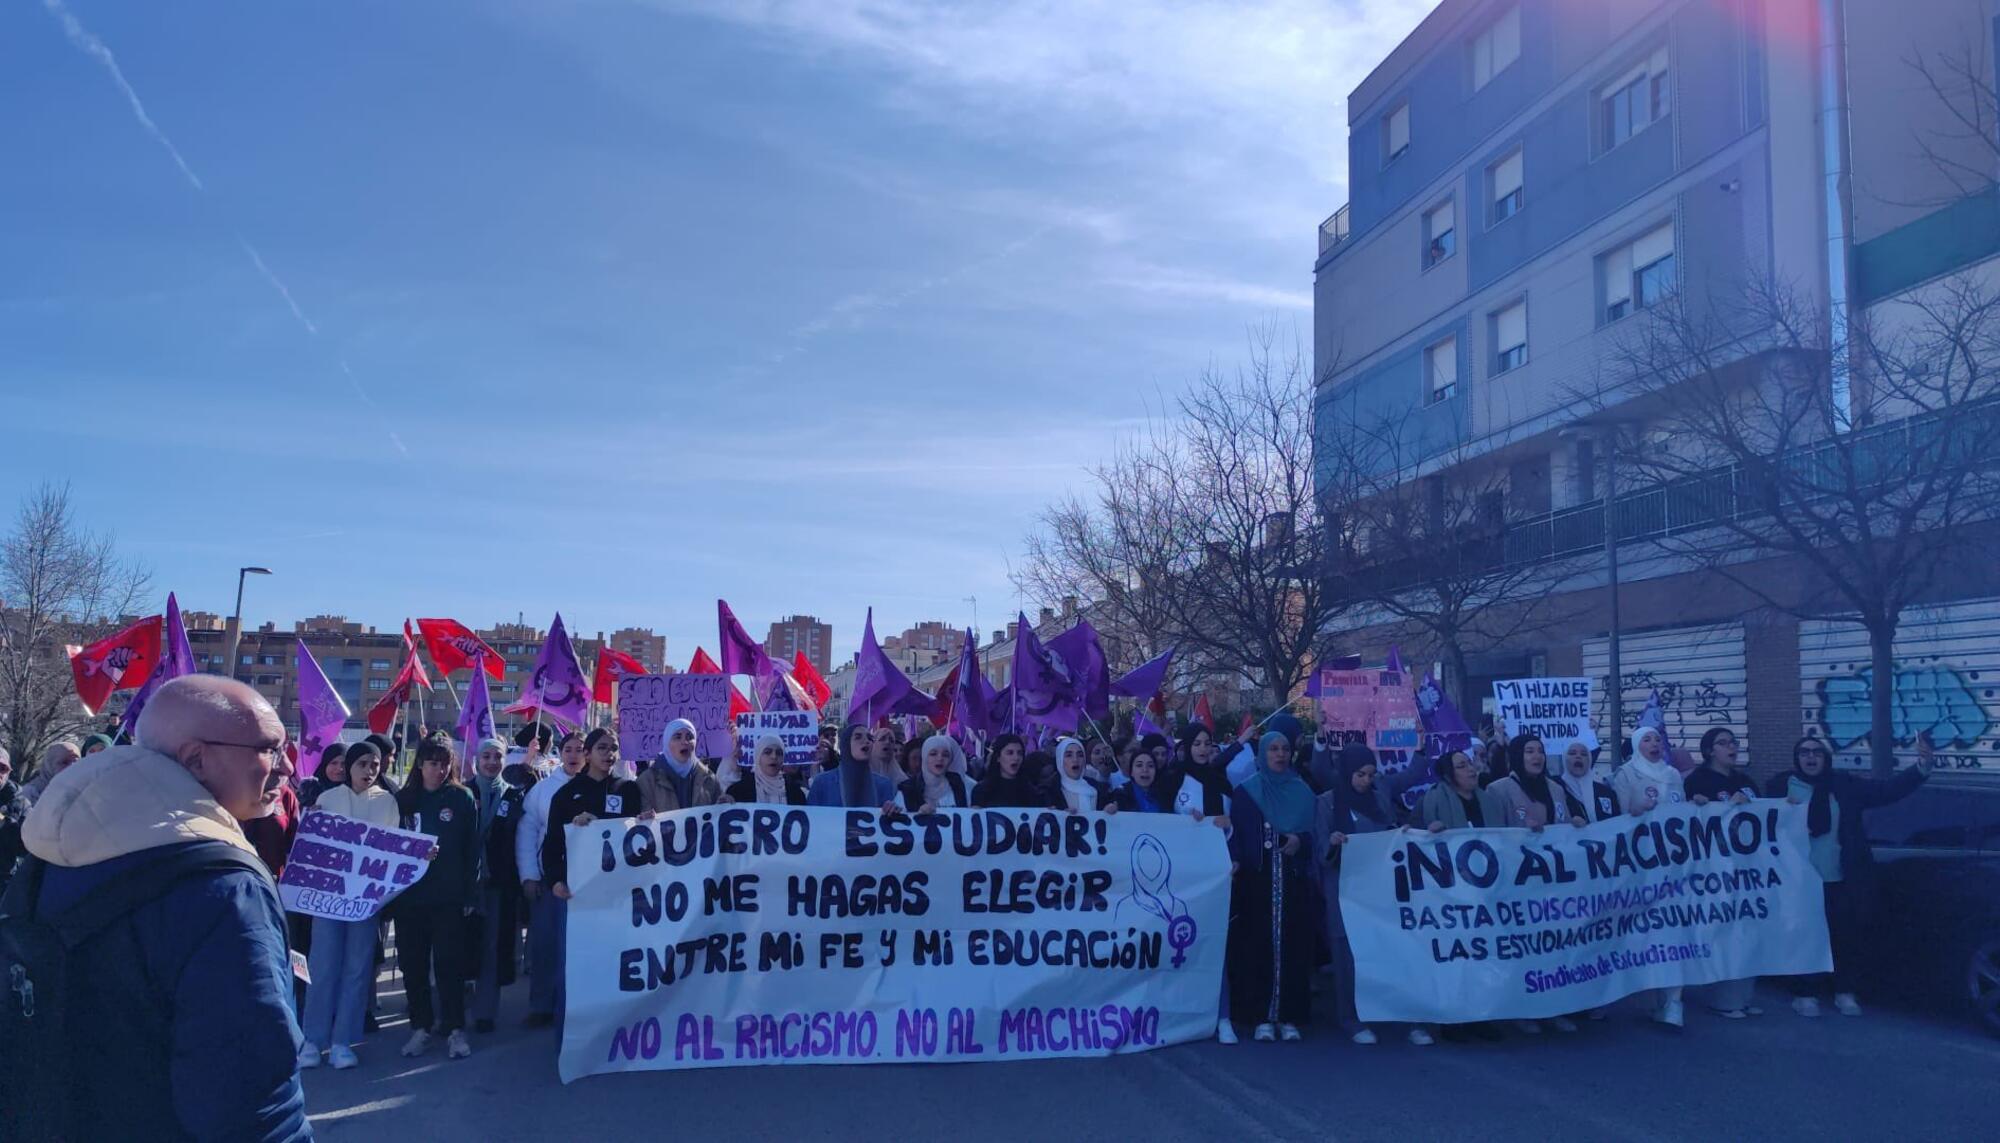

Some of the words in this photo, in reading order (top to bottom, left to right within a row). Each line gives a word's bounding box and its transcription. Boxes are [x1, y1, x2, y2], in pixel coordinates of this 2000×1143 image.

[1391, 839, 1500, 903] ¡NO
[1514, 844, 1577, 886] AL
[1577, 808, 1780, 879] RACISMO!
[631, 881, 689, 928] NO
[703, 874, 760, 916] ME
[787, 871, 930, 918] HAGAS
[1400, 904, 1495, 931] BASTA
[1496, 901, 1526, 926] DE
[1689, 867, 1782, 896] CONTRA
[1431, 937, 1489, 964] LAS
[1496, 914, 1613, 960] ESTUDIANTES
[1617, 896, 1769, 939] MUSULMANAS
[619, 931, 748, 992] ENTRE
[819, 932, 864, 969] FE
[1524, 962, 1598, 993] Sindicato
[1594, 954, 1614, 976] de
[607, 1016, 662, 1063] NO
[674, 1012, 725, 1061] AL
[895, 1007, 938, 1058] NO
[946, 1006, 984, 1056] AL
